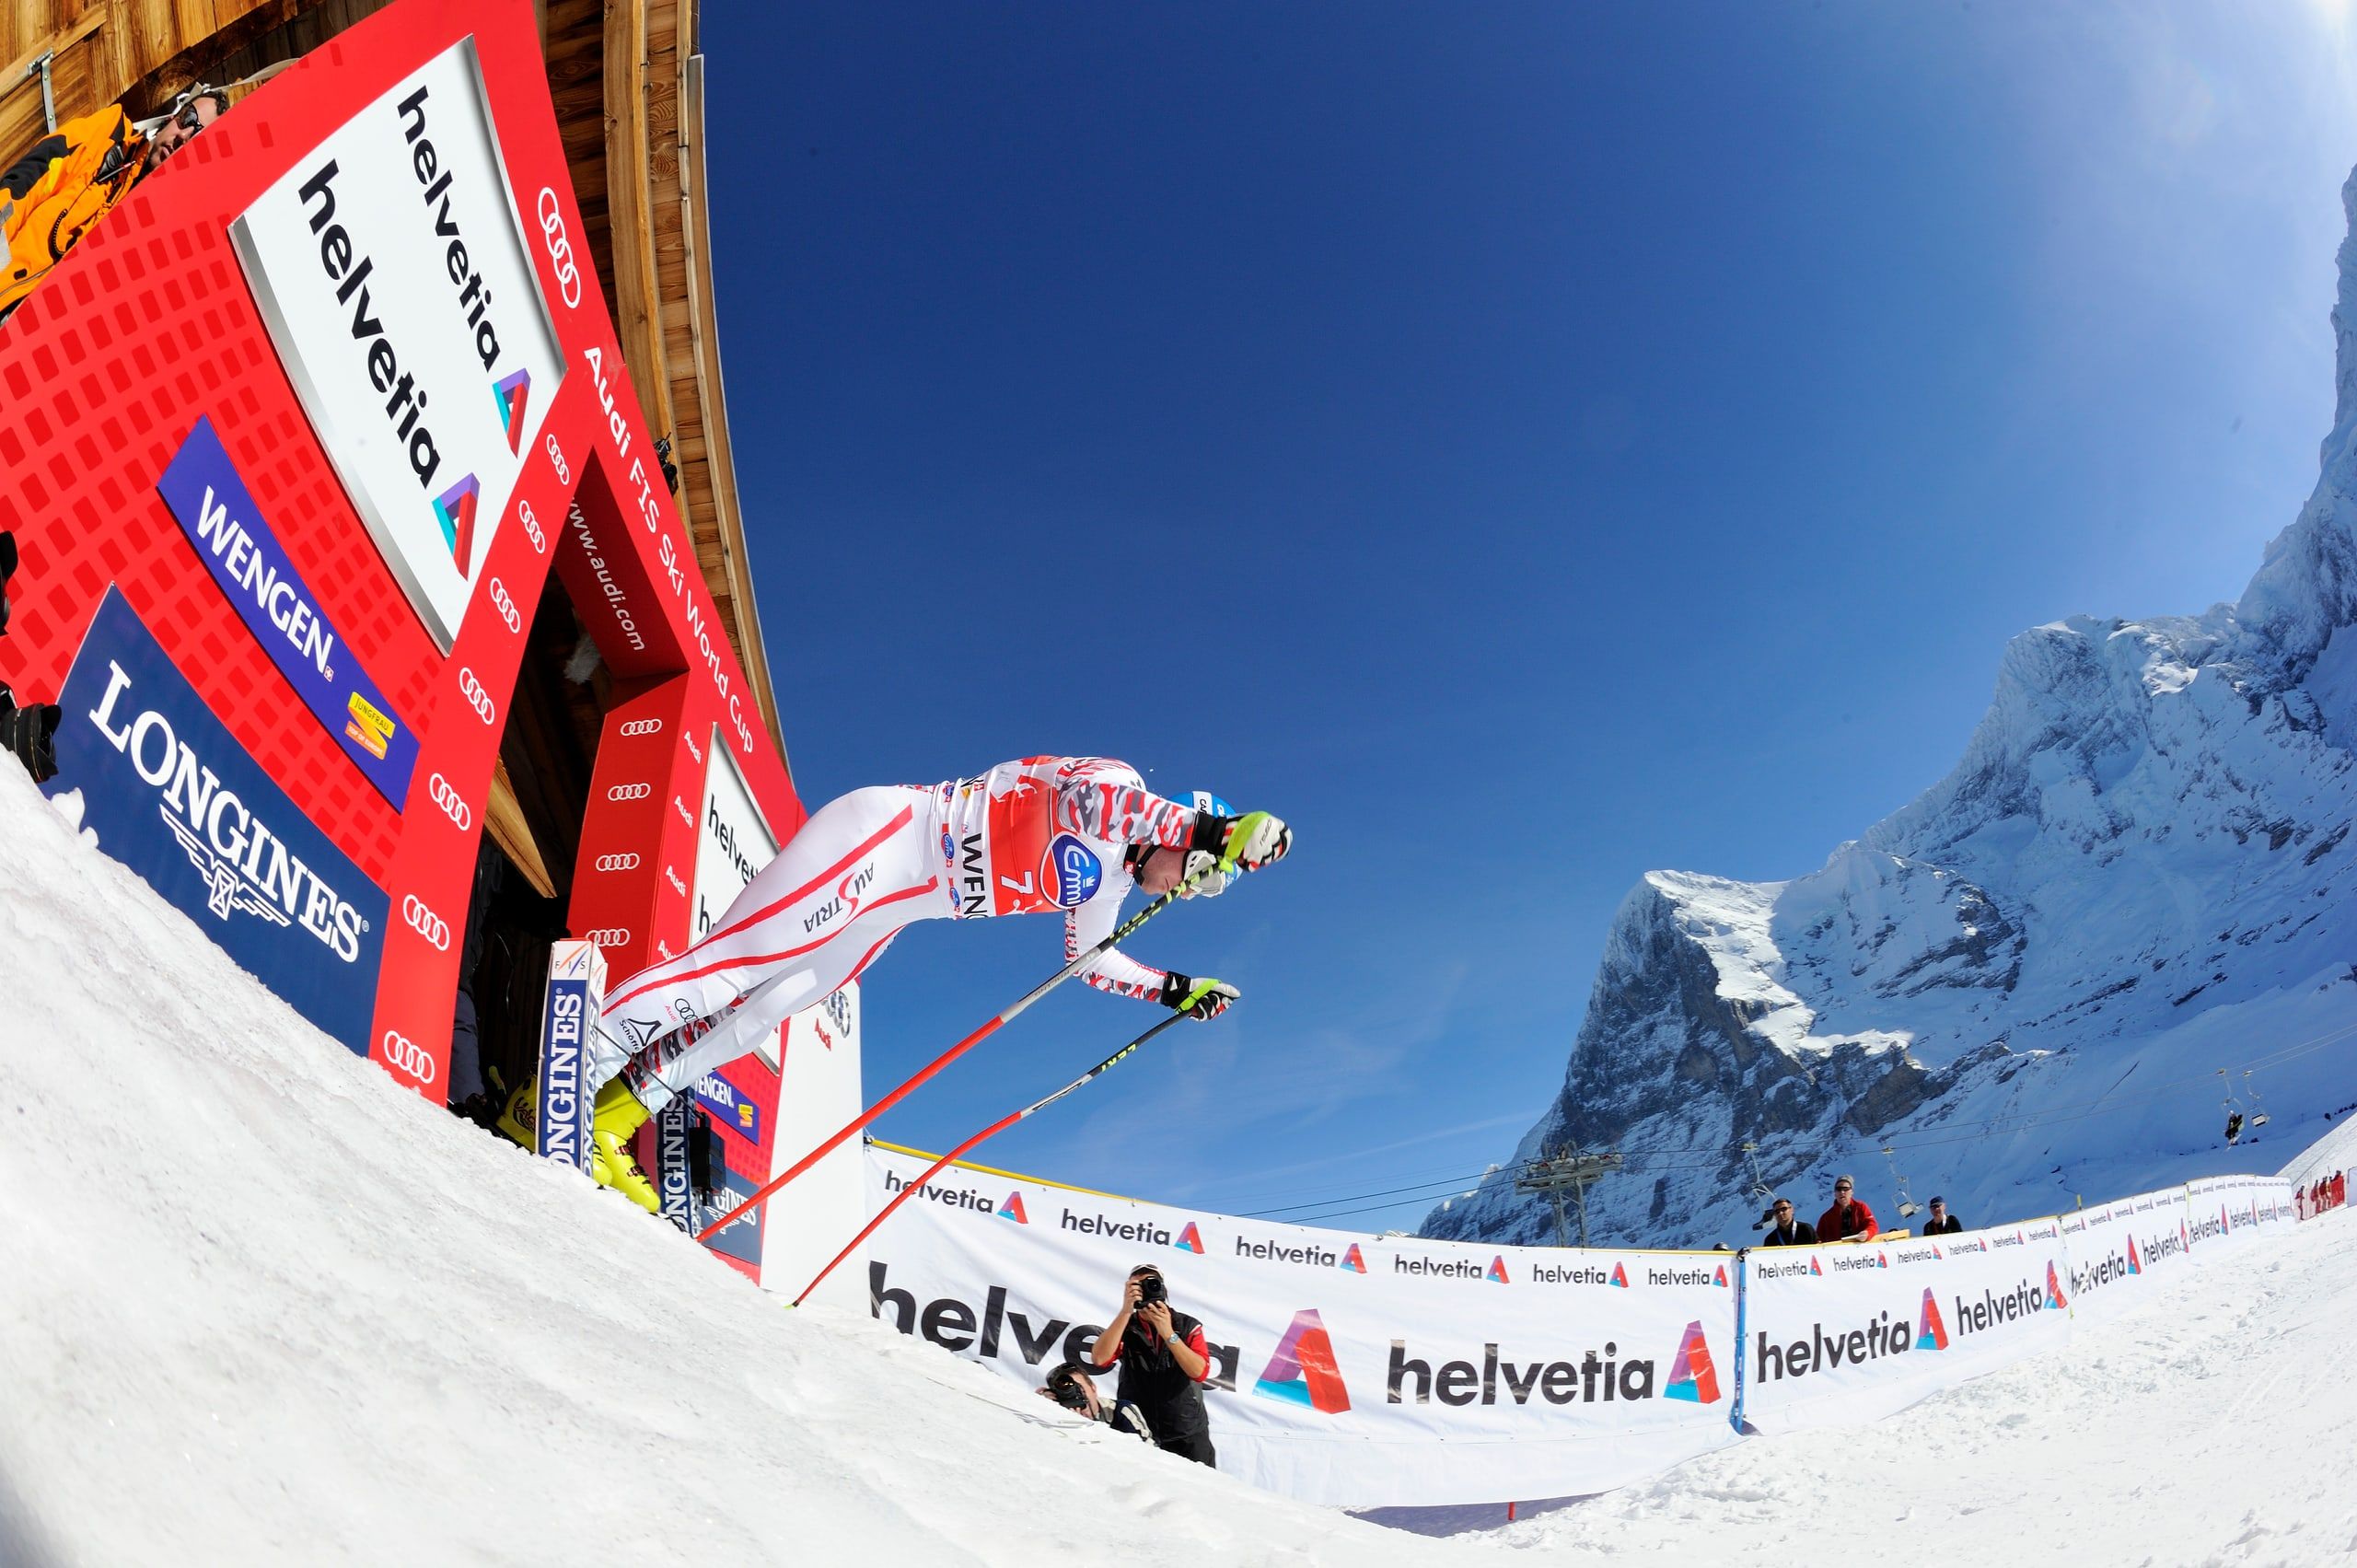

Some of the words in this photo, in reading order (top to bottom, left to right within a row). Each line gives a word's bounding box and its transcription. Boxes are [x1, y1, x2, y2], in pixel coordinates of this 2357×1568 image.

[398, 85, 501, 373] helvetia
[298, 158, 441, 489] helvetia
[584, 347, 631, 458] Audi
[630, 457, 660, 533] FIS
[659, 534, 684, 597] Ski
[687, 589, 729, 699] World
[730, 694, 752, 753] Cup
[195, 486, 333, 673] WENGEN
[684, 731, 701, 763] Audi
[89, 660, 362, 963] LONGINES
[674, 796, 693, 828] Audi
[666, 865, 686, 898] Audi
[1001, 870, 1033, 894] 7
[1064, 844, 1090, 905] Emmi
[804, 862, 874, 934] AUSTRIA
[665, 1005, 678, 1022] Audi
[546, 993, 583, 1165] ONGINES
[1061, 1208, 1170, 1247] helvetia
[1993, 1234, 2016, 1248] helvetia
[1237, 1236, 1336, 1268] helvetia
[1833, 1255, 1875, 1272] helvetia
[1898, 1249, 1932, 1264] helvetia
[1948, 1240, 1979, 1256] helvetia
[2142, 1229, 2182, 1266] helvetia
[1394, 1254, 1482, 1280] helvetia
[1533, 1264, 1607, 1285] helvetia
[1649, 1269, 1710, 1286] helvetia
[1759, 1262, 1807, 1279] helvetia
[2072, 1249, 2126, 1297] helvetia
[869, 1260, 1239, 1392] helvea
[1956, 1279, 2042, 1336] helvetia
[1758, 1310, 1910, 1383] helvetia
[1387, 1340, 1655, 1406] helvetia
